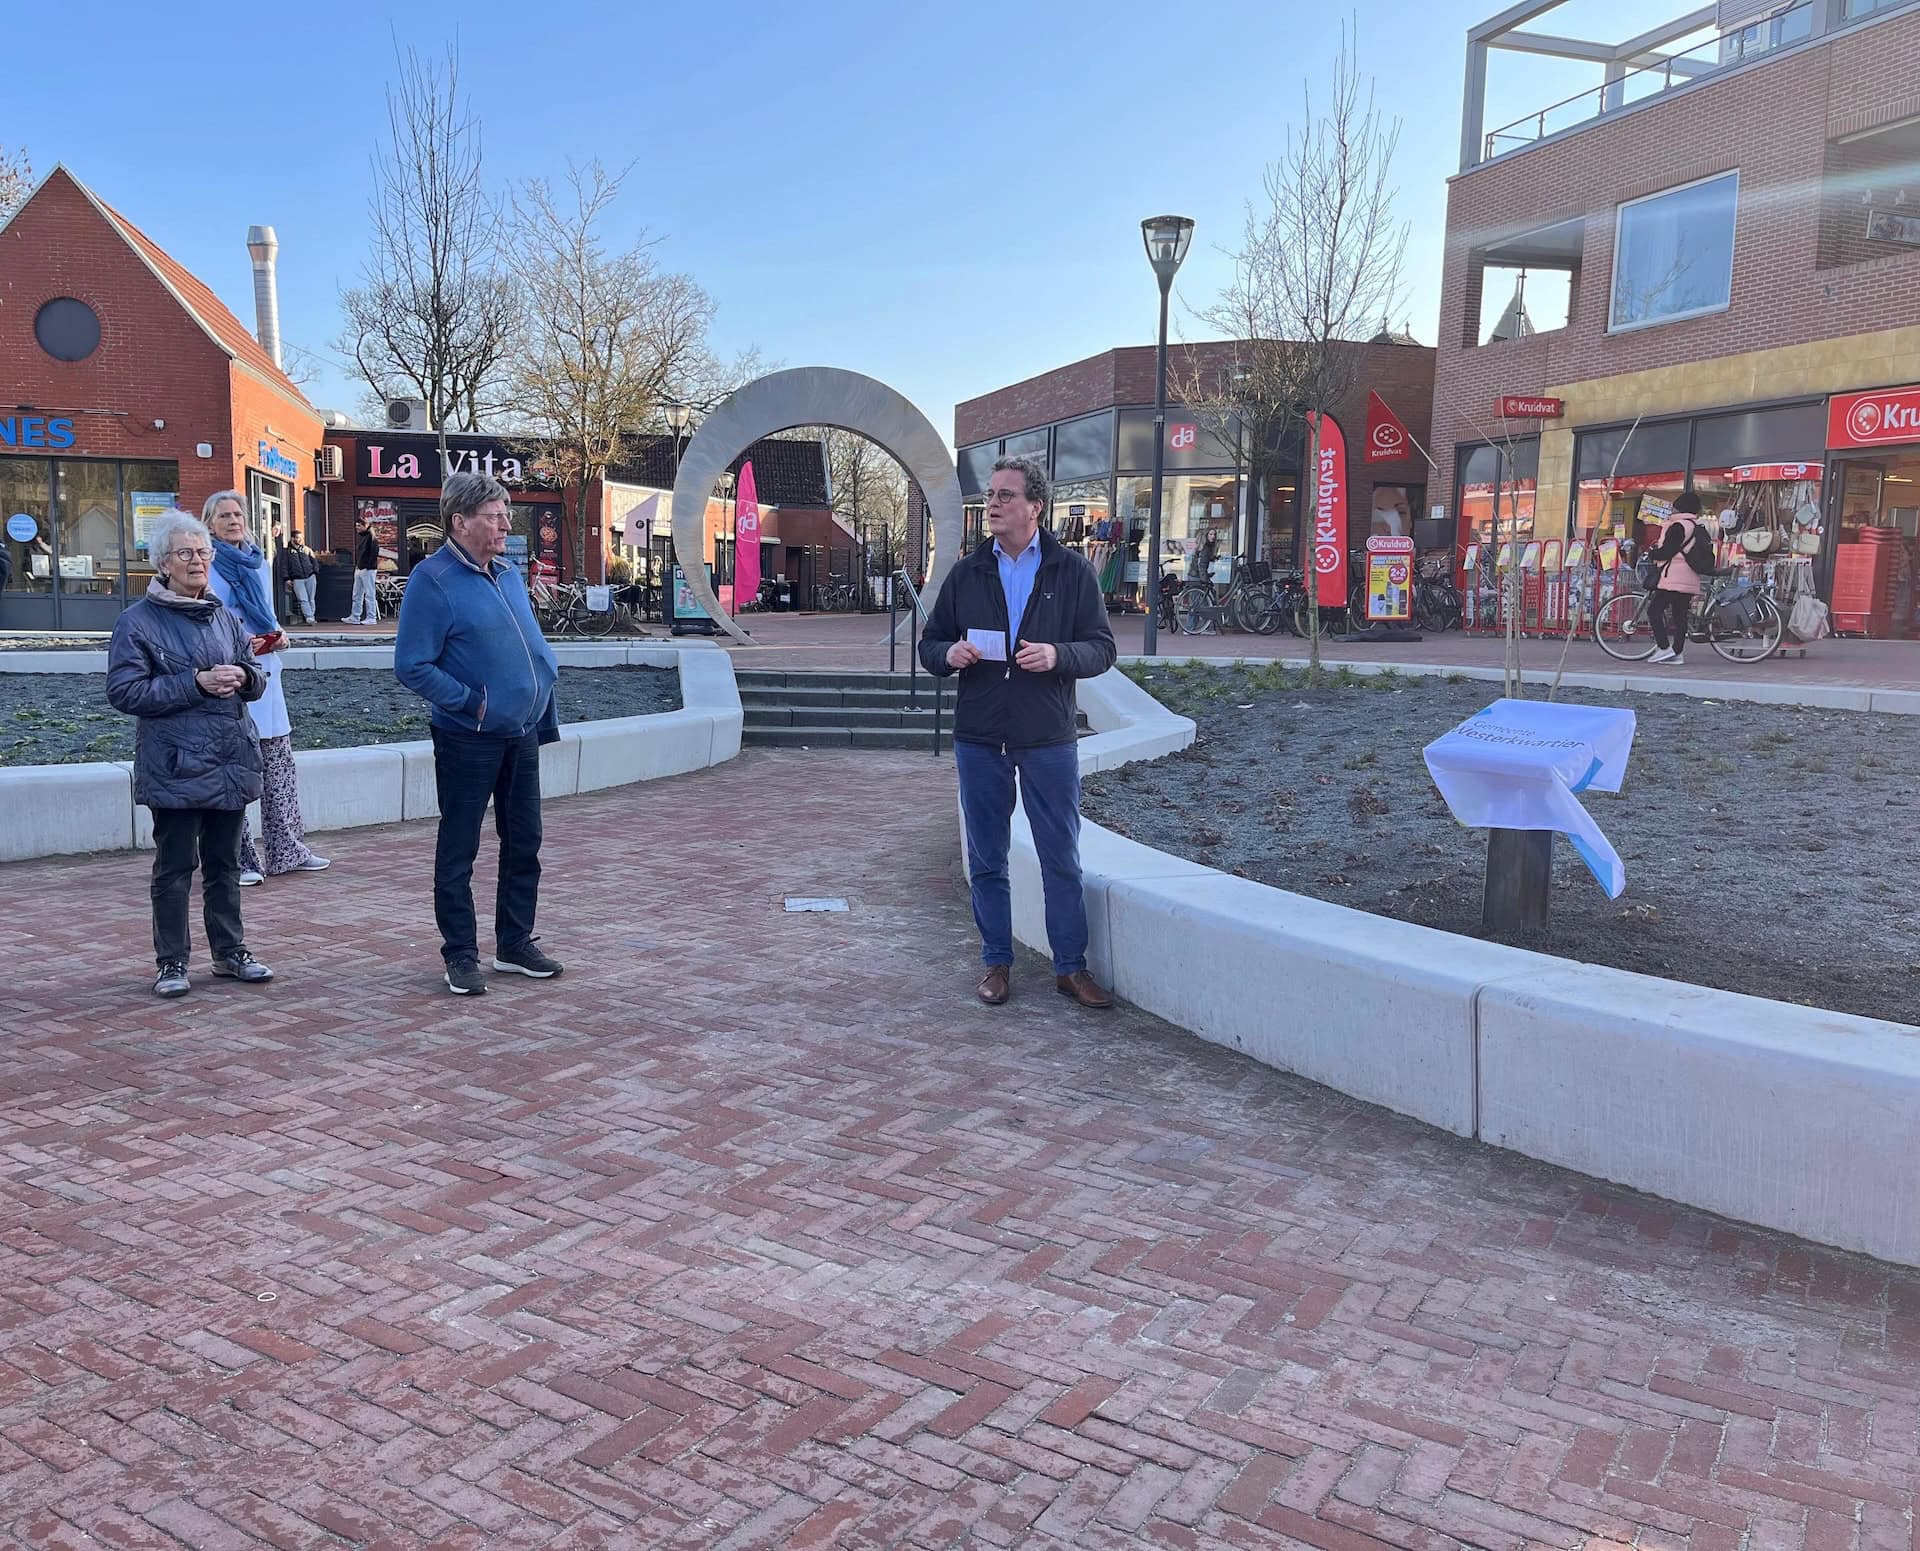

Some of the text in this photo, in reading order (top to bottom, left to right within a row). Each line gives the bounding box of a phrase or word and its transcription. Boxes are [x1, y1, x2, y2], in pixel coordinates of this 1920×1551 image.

[1518, 401, 1555, 413] Kruidvat
[0, 416, 76, 448] NES
[1172, 427, 1194, 448] da
[1372, 448, 1402, 457] Kruidvat
[367, 446, 523, 482] La Vita
[1378, 540, 1411, 549] Kruidvat
[1390, 567, 1406, 577] 2+2
[1473, 720, 1536, 736] Gemeente
